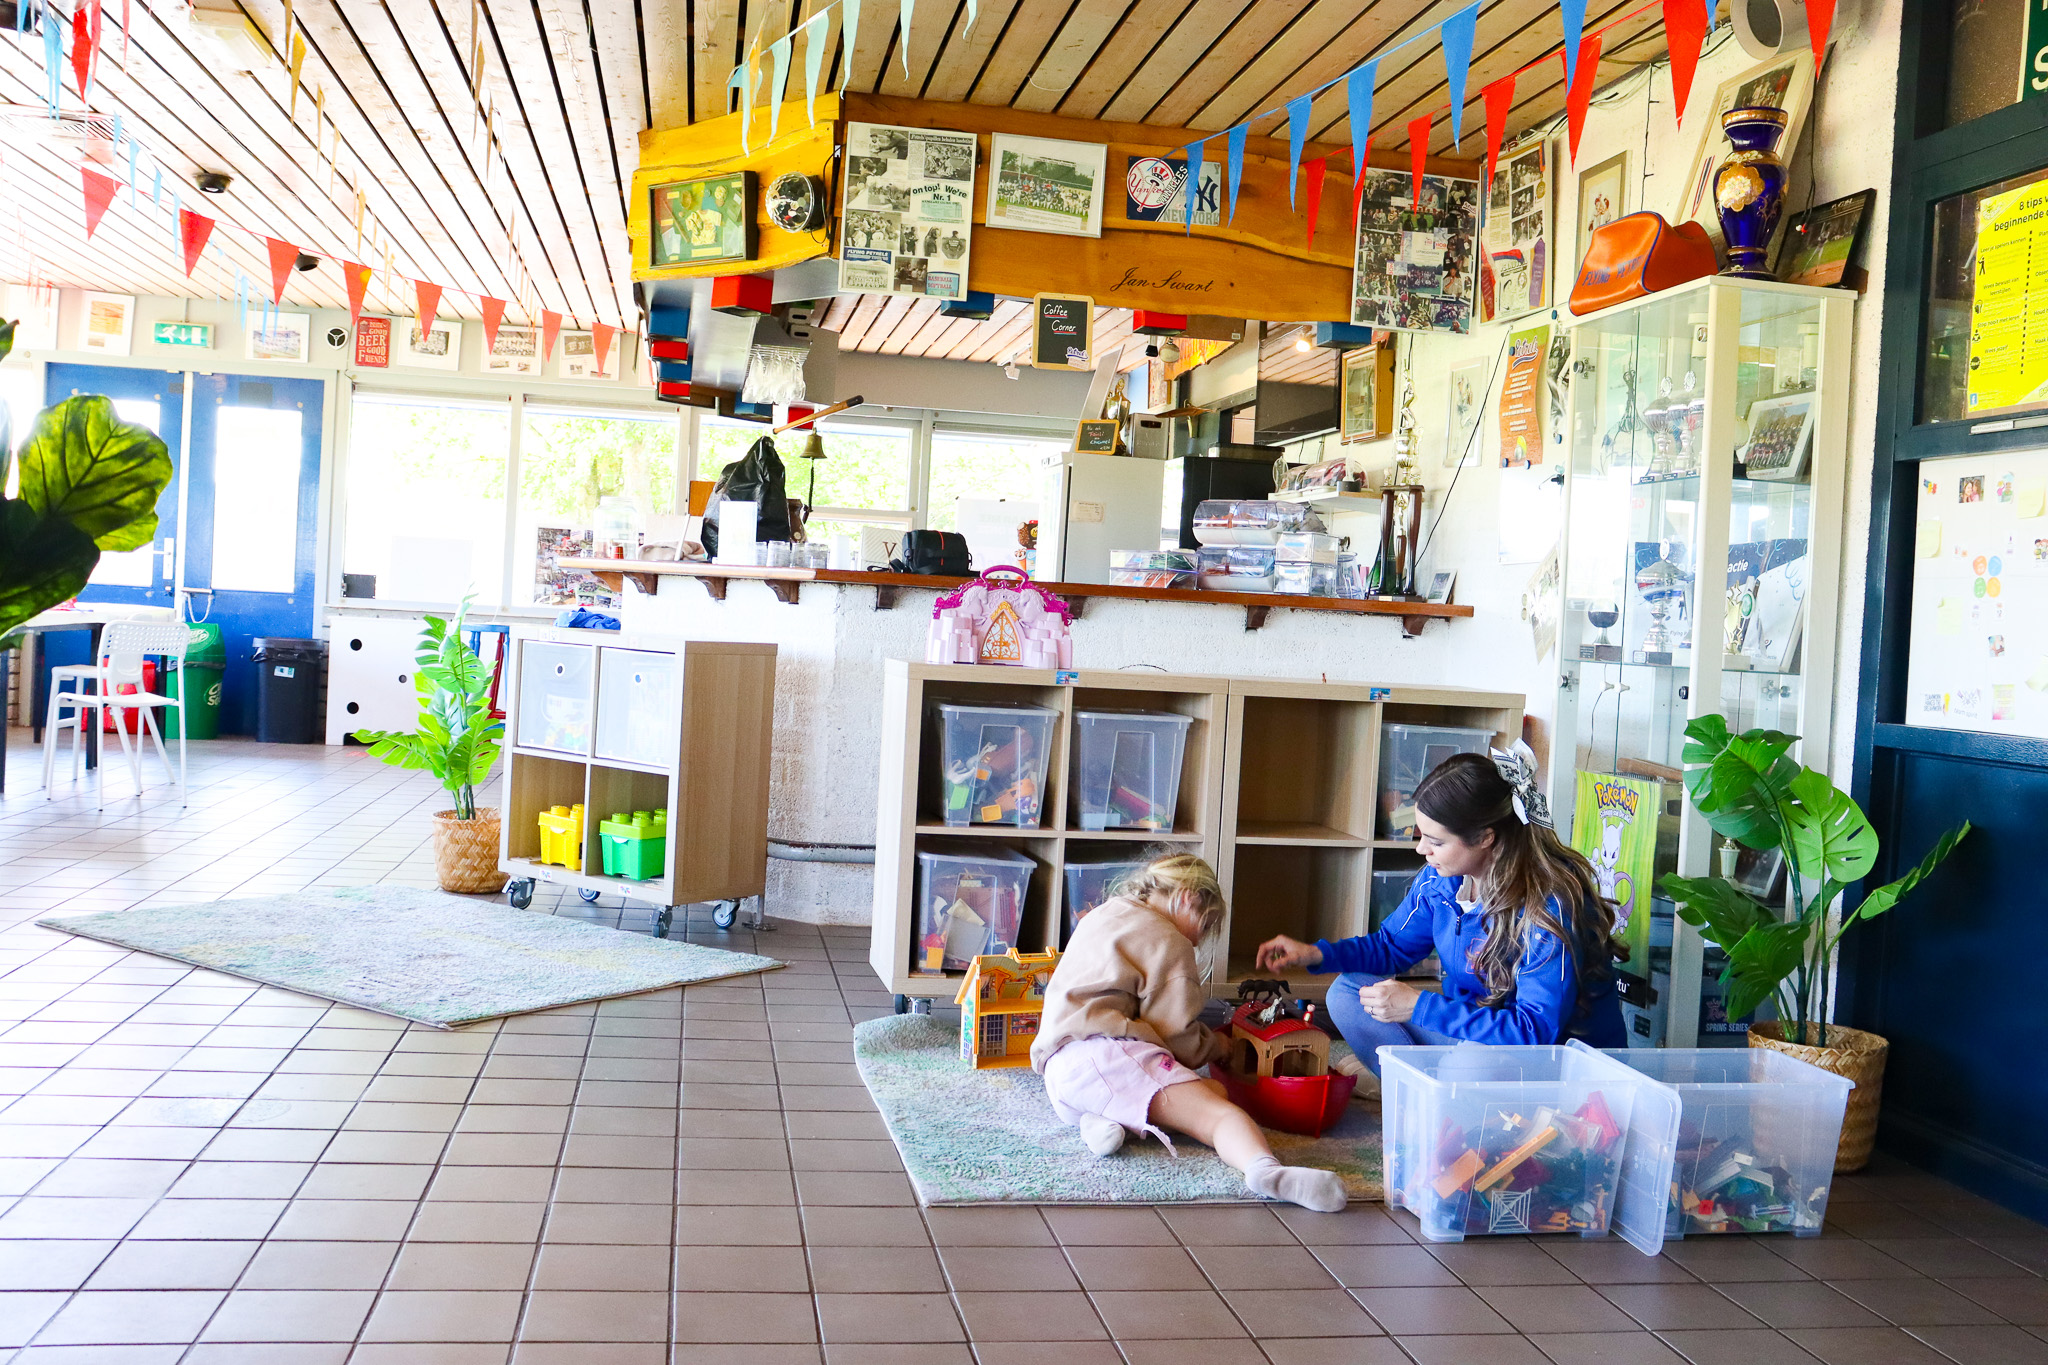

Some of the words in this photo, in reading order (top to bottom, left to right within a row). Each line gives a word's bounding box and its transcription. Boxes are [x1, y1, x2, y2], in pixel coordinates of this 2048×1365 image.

[912, 186, 924, 194] on
[924, 183, 941, 193] top!
[945, 184, 967, 198] We're
[1156, 165, 1188, 204] YANKEES
[933, 193, 945, 201] Nr.
[2019, 201, 2024, 210] 8
[2027, 197, 2043, 209] tips
[1163, 208, 1187, 222] NEW
[1192, 211, 1219, 225] YORK
[1994, 210, 2044, 231] beginnende
[1109, 266, 1149, 292] Jan
[1152, 270, 1214, 292] Swart
[1582, 266, 1611, 286] FLYING
[1043, 304, 1068, 316] Coffee
[1051, 319, 1077, 332] Corner
[358, 334, 387, 347] BEER
[358, 349, 387, 363] FRIENDS
[367, 346, 387, 356] GOOD
[1705, 1022, 1727, 1032] SPRING
[1728, 1022, 1749, 1032] SERIES
